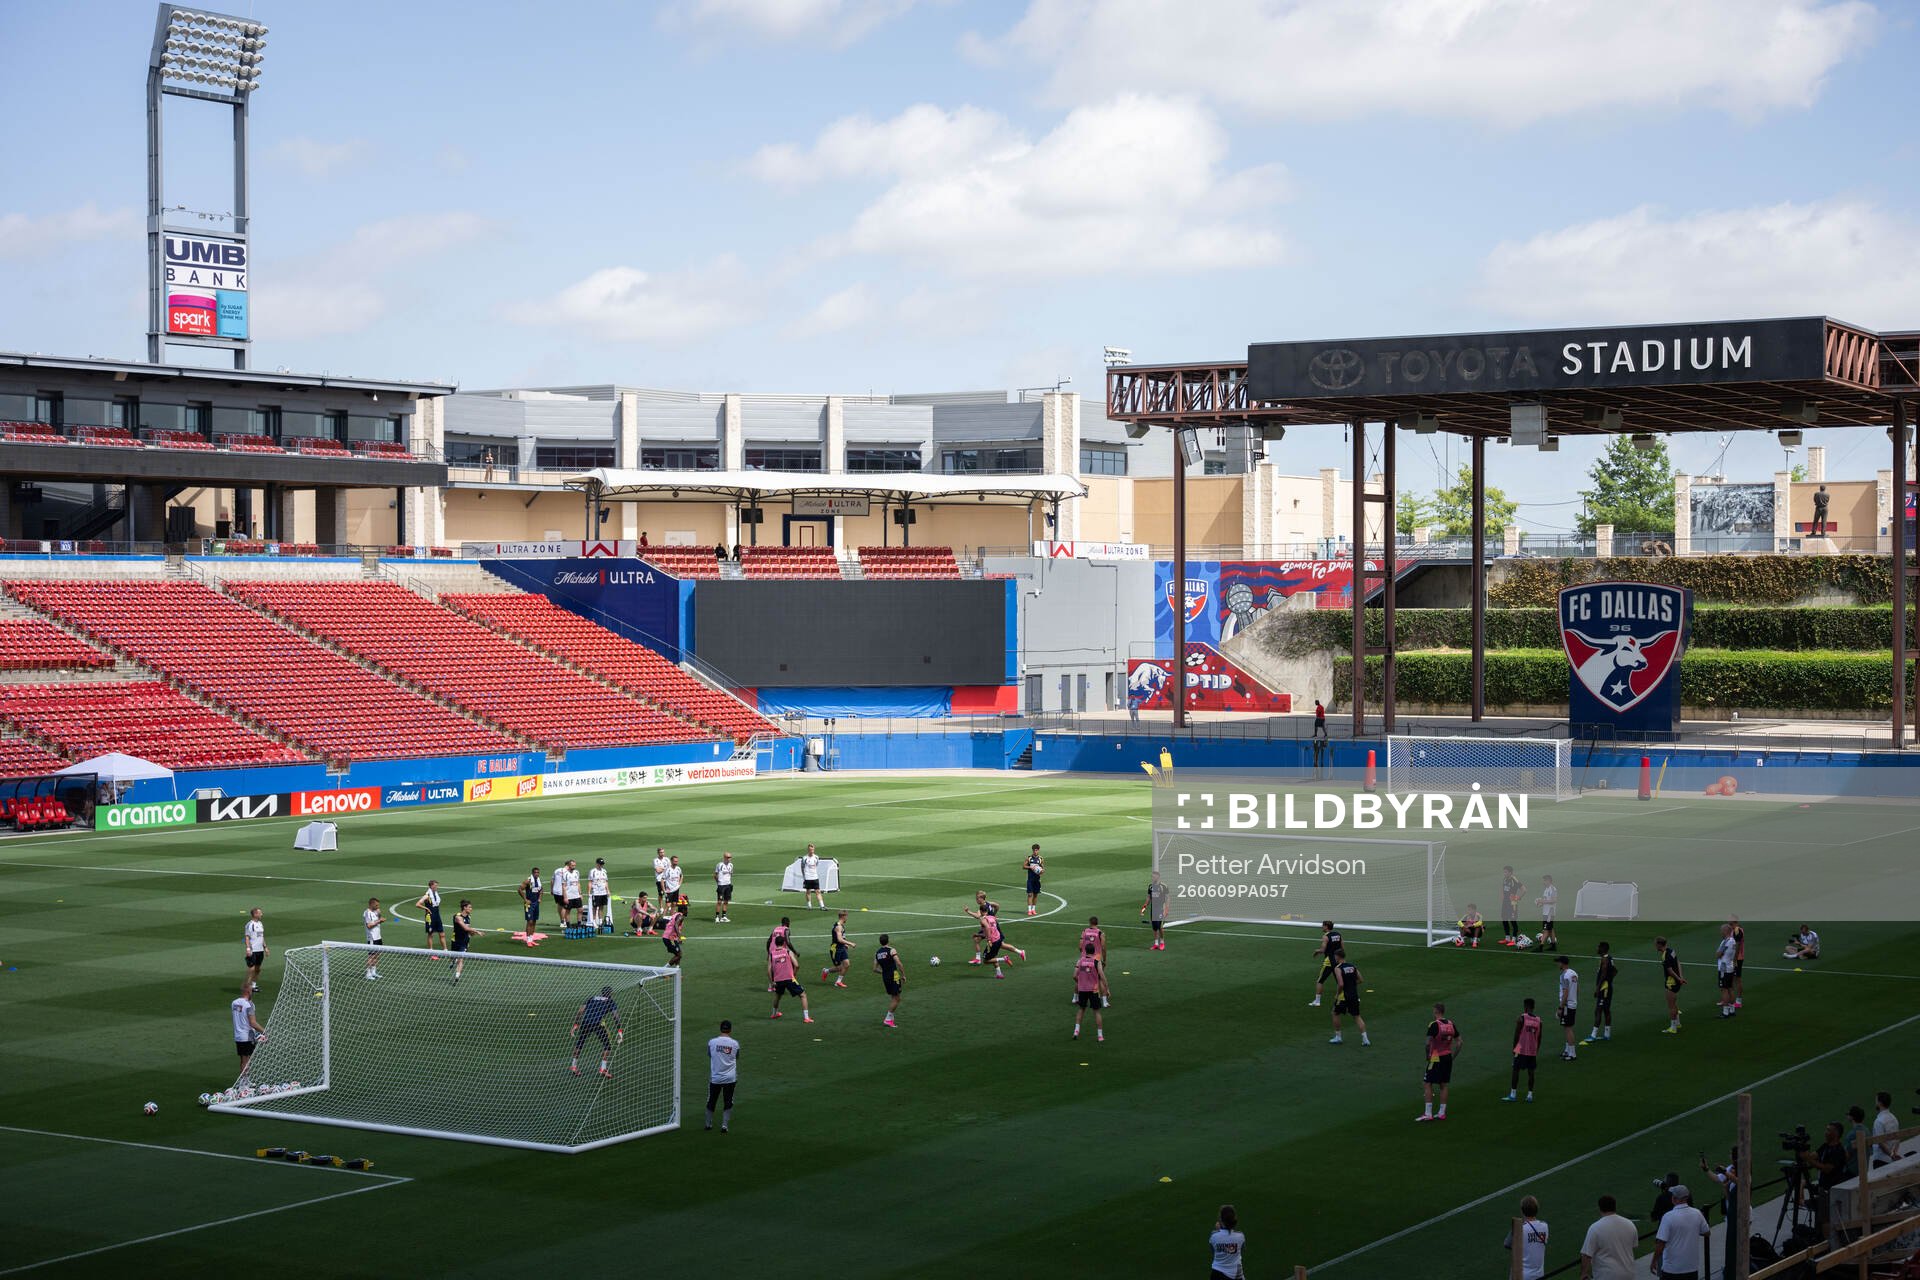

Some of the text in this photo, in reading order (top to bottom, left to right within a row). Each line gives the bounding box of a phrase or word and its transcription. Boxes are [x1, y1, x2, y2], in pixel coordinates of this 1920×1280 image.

[166, 239, 245, 266] UMB
[166, 268, 245, 288] BANK
[173, 310, 211, 328] spark
[1377, 336, 1751, 384] TOYOTA STADIUM
[834, 500, 862, 508] ULTRA
[502, 545, 528, 553] ULTRA
[532, 544, 561, 553] ZONE
[1126, 547, 1143, 555] ZONE
[554, 571, 654, 585] Michelob ULTRA
[1312, 562, 1326, 579] FC
[1185, 581, 1205, 592] ALLAS
[1569, 590, 1673, 622] FC DALLAS
[1609, 624, 1632, 632] 96
[1185, 672, 1232, 689] DTID
[478, 757, 517, 773] FC DALLAS
[687, 766, 754, 779] verizon business
[543, 777, 608, 788] BANK OF AMERICA
[301, 792, 371, 814] Lenovo
[386, 788, 459, 804] Michelob ULTRA
[107, 803, 186, 826] aramco
[210, 794, 278, 821] KIA
